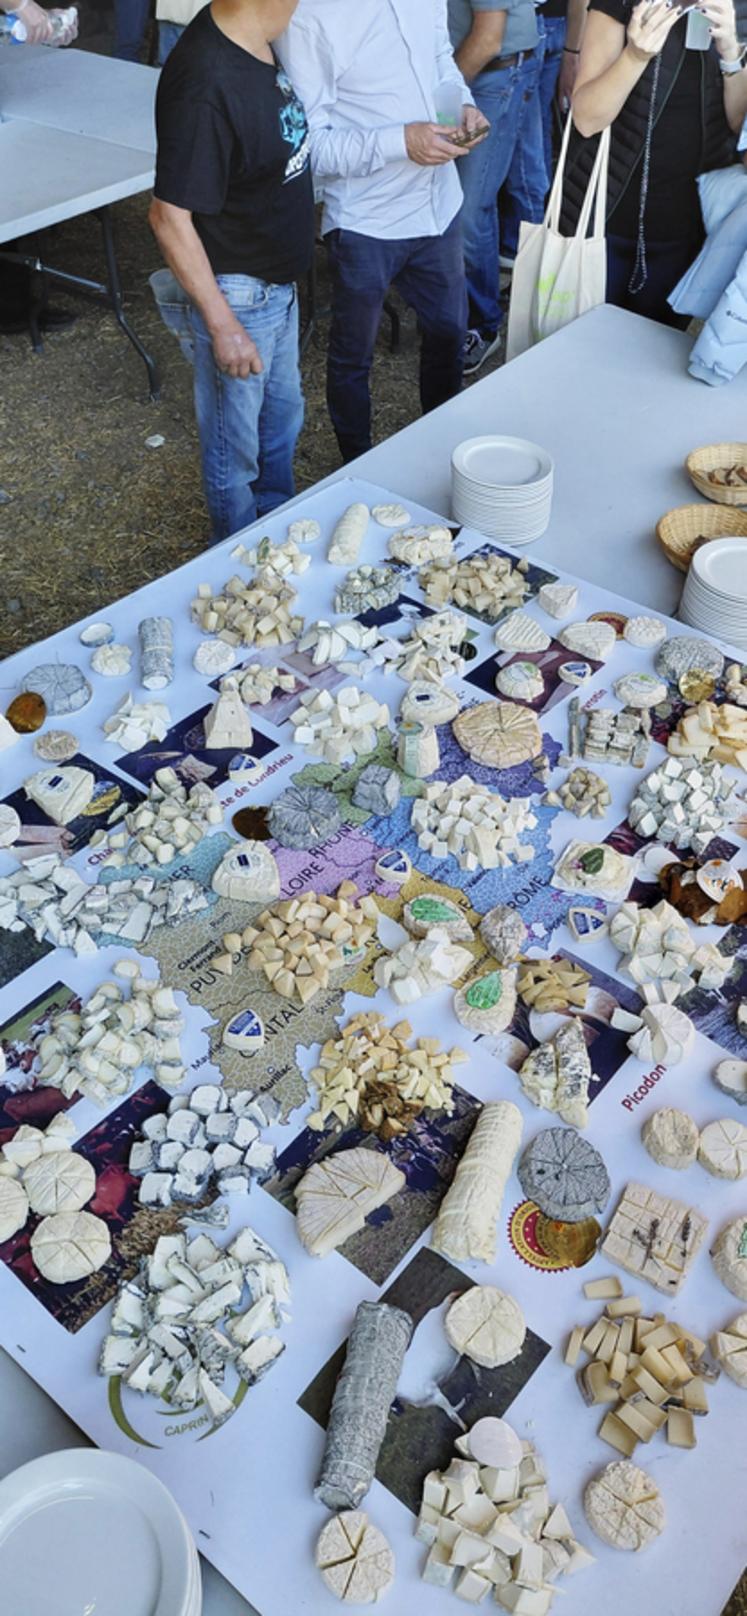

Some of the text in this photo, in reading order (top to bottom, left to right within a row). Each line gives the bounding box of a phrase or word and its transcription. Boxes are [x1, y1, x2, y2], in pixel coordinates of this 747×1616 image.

[234, 786, 249, 797] de
[281, 861, 324, 896] LOIRE
[506, 875, 550, 910] RÔME
[621, 1064, 667, 1111] Picodon
